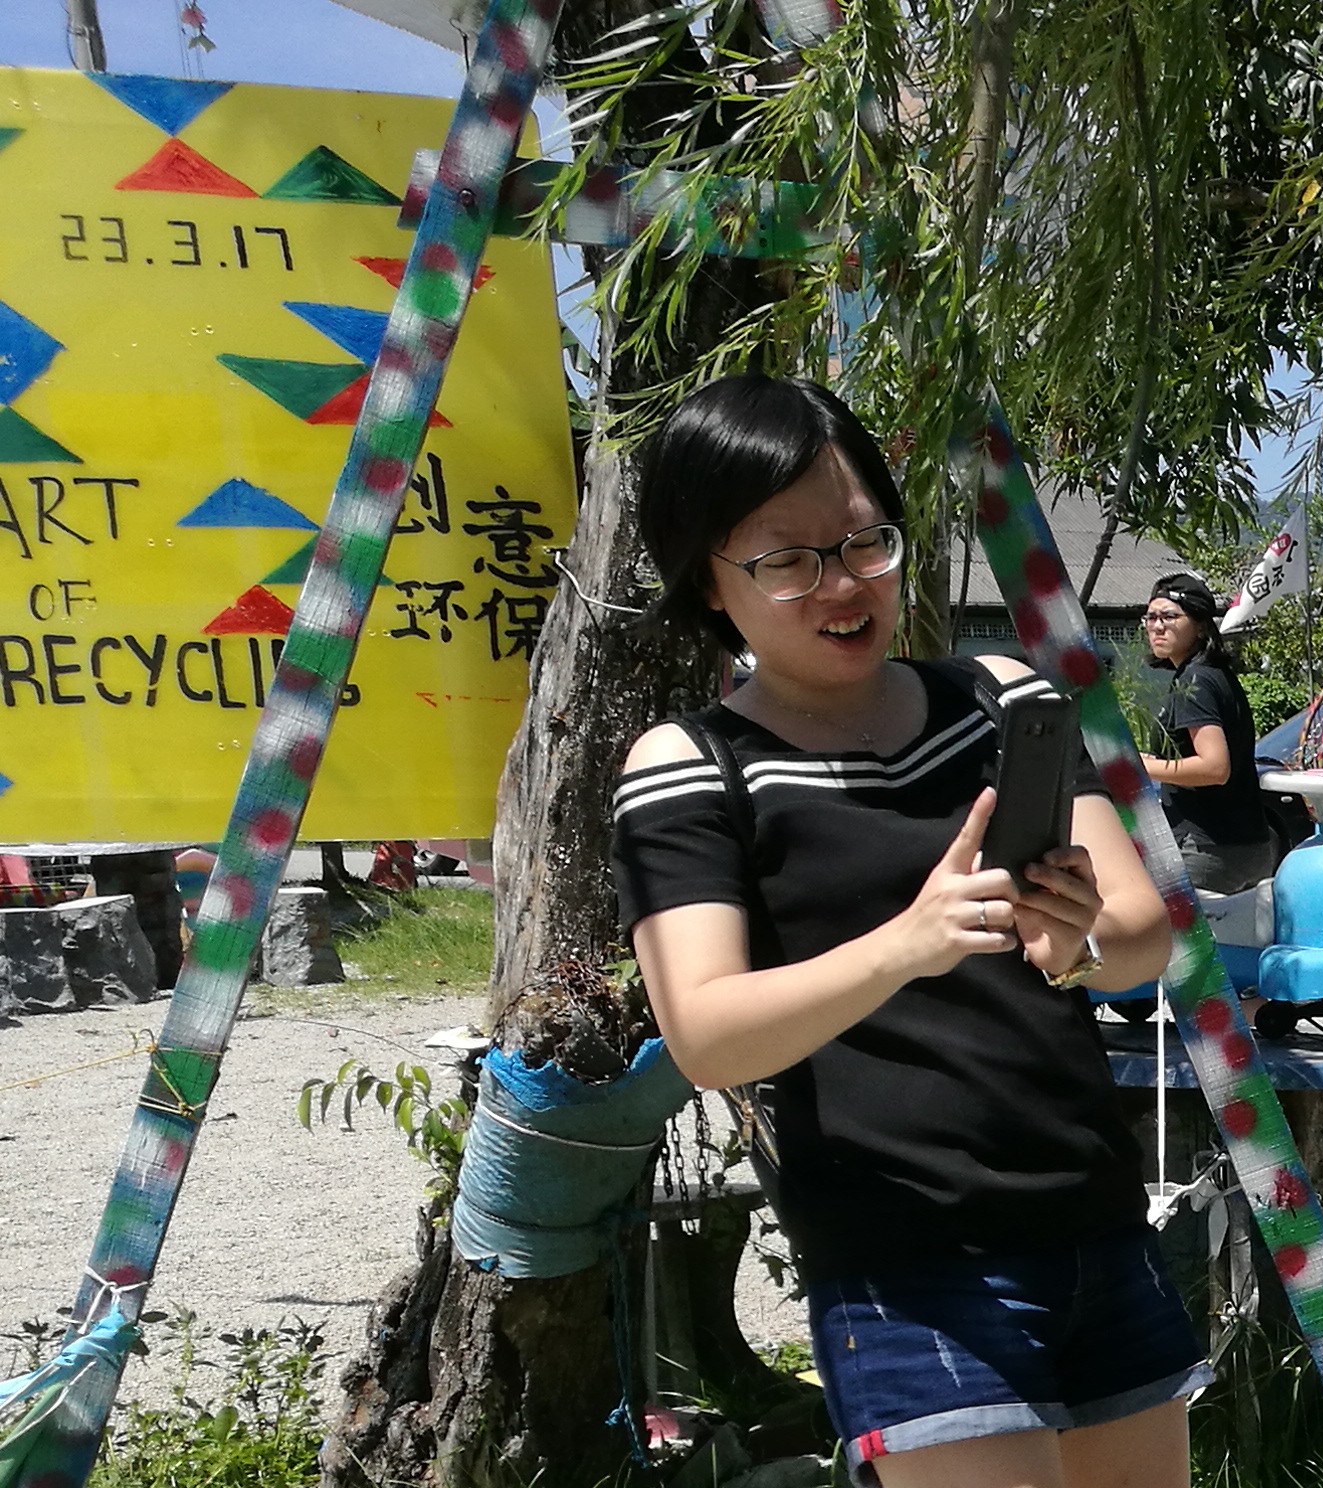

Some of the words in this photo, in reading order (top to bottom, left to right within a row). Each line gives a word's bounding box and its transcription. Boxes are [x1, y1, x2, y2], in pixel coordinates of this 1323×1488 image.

[60, 214, 294, 272] 23.3.17
[28, 578, 97, 621] OF
[390, 580, 551, 662] 环保
[0, 633, 361, 709] RECYCLI
